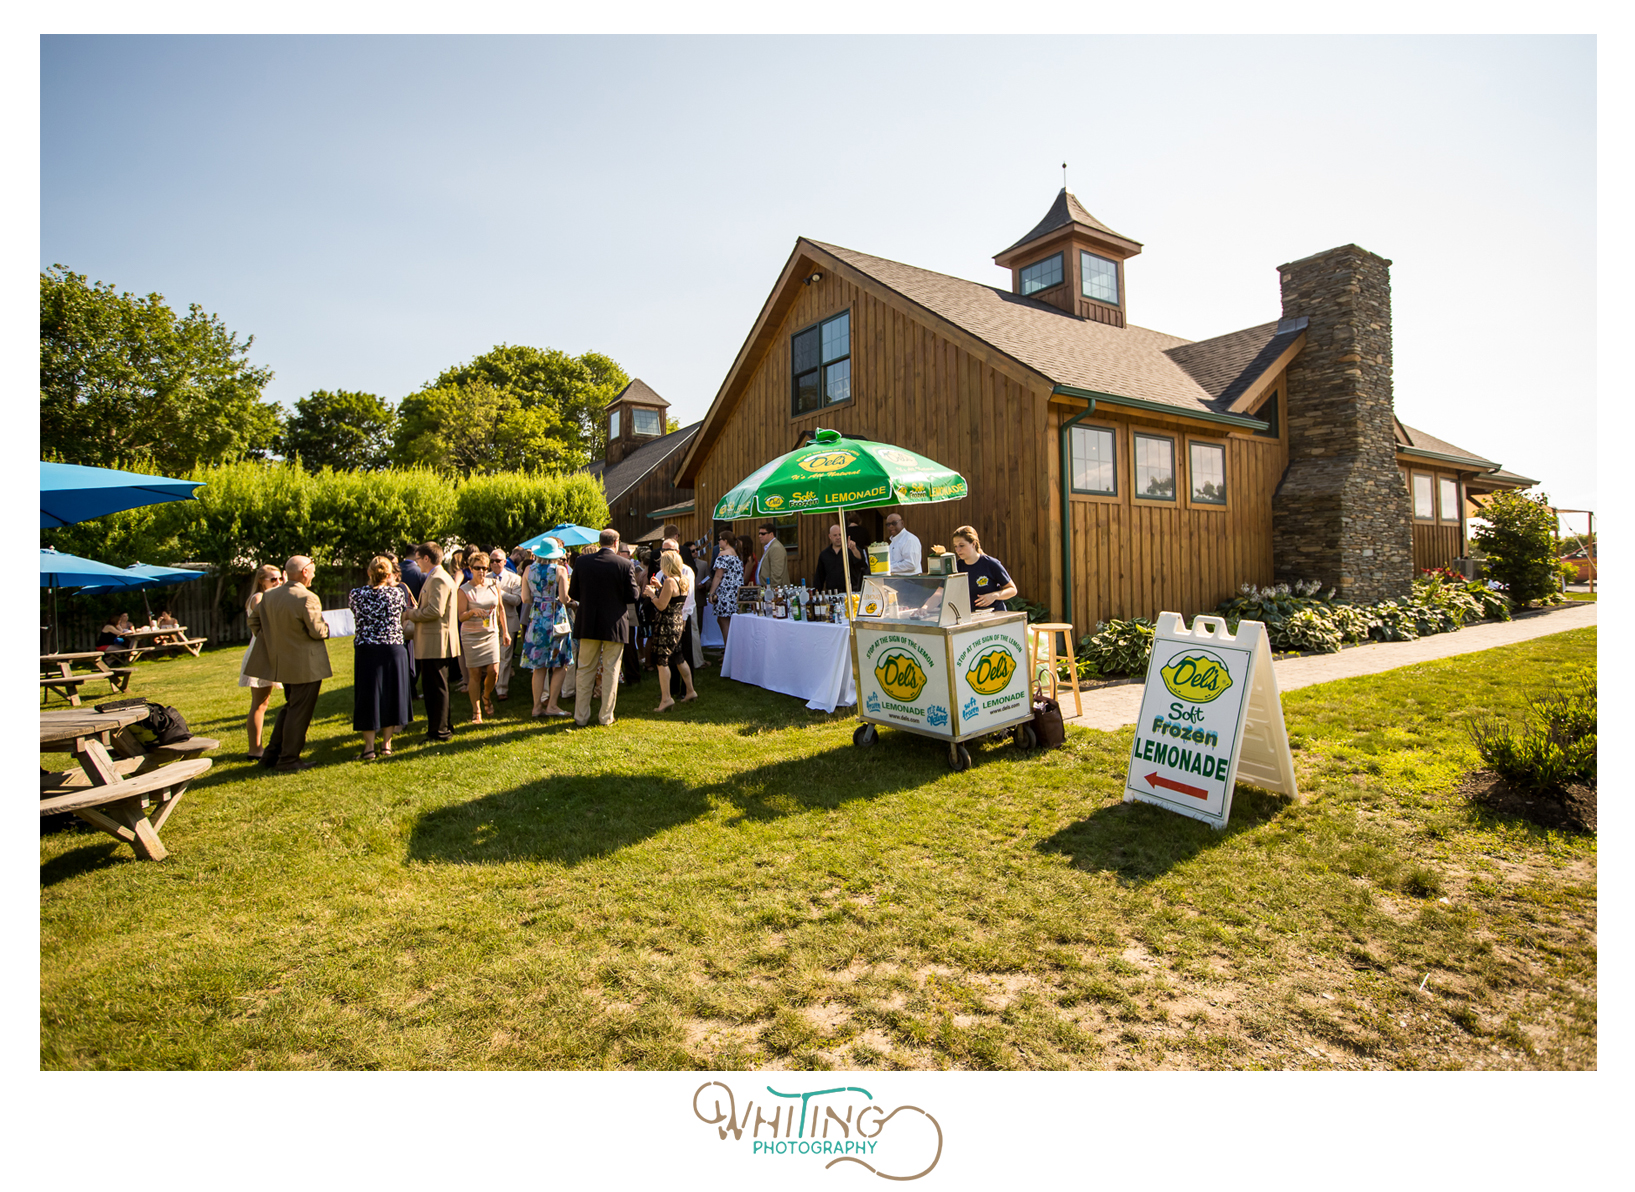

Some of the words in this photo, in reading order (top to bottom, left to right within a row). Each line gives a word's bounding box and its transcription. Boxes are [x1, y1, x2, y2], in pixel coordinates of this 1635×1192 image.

[809, 455, 846, 468] Del's
[827, 469, 861, 477] Natural
[792, 490, 817, 502] Soft
[825, 486, 886, 504] LEMONADE
[929, 483, 965, 497] LEMONADE
[789, 498, 819, 508] Frozen
[866, 644, 875, 660] STOP
[874, 640, 880, 648] AT
[879, 637, 889, 645] THE
[888, 635, 900, 643] SIGN
[908, 639, 917, 649] THE
[917, 645, 935, 668] LEMON
[956, 651, 967, 667] STOP
[966, 645, 973, 654] AT
[972, 638, 982, 648] THE
[981, 635, 993, 643] SIGN
[1000, 634, 1009, 642] THE
[1008, 637, 1023, 653] LEMON
[885, 659, 919, 689] Del's
[977, 655, 1010, 685] Del's
[1173, 659, 1220, 691] Del's
[982, 690, 1025, 709] LEMONADE
[989, 702, 1020, 715] www.dels.com
[881, 701, 926, 717] LEMONADE
[1168, 702, 1205, 724] Soft
[888, 713, 920, 724] www.dels.com
[1152, 715, 1219, 749] Frozen
[1134, 737, 1229, 782] LEMONADE
